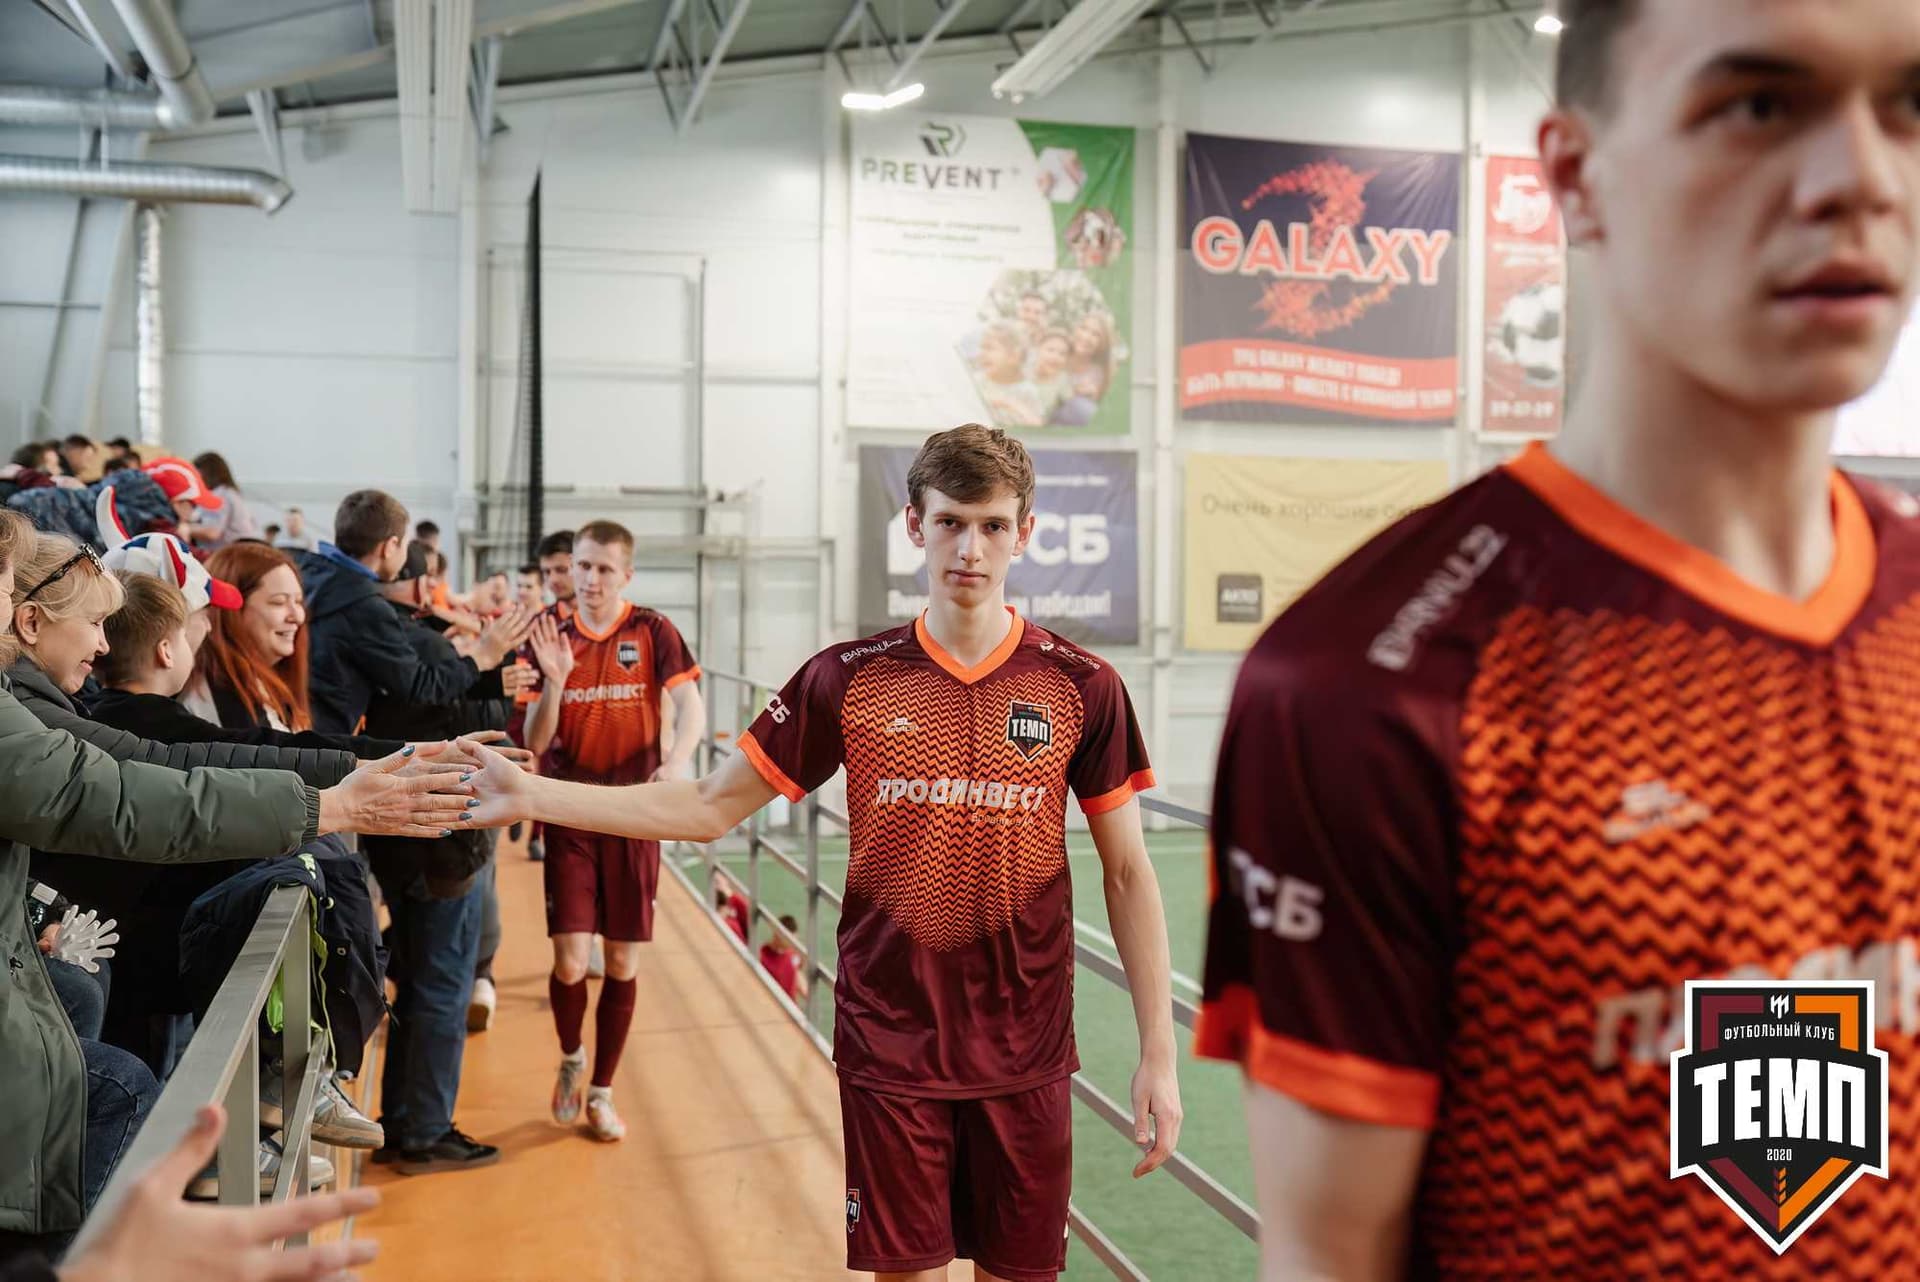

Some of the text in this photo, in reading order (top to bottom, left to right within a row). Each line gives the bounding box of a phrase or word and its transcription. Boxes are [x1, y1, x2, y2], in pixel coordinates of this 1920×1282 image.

[861, 157, 1002, 190] PREVENT
[1192, 216, 1451, 284] GALAXY
[1010, 512, 1111, 566] СБ
[1011, 718, 1048, 742] ТЕМП
[876, 778, 1047, 811] ПРОДИНВЕСТ
